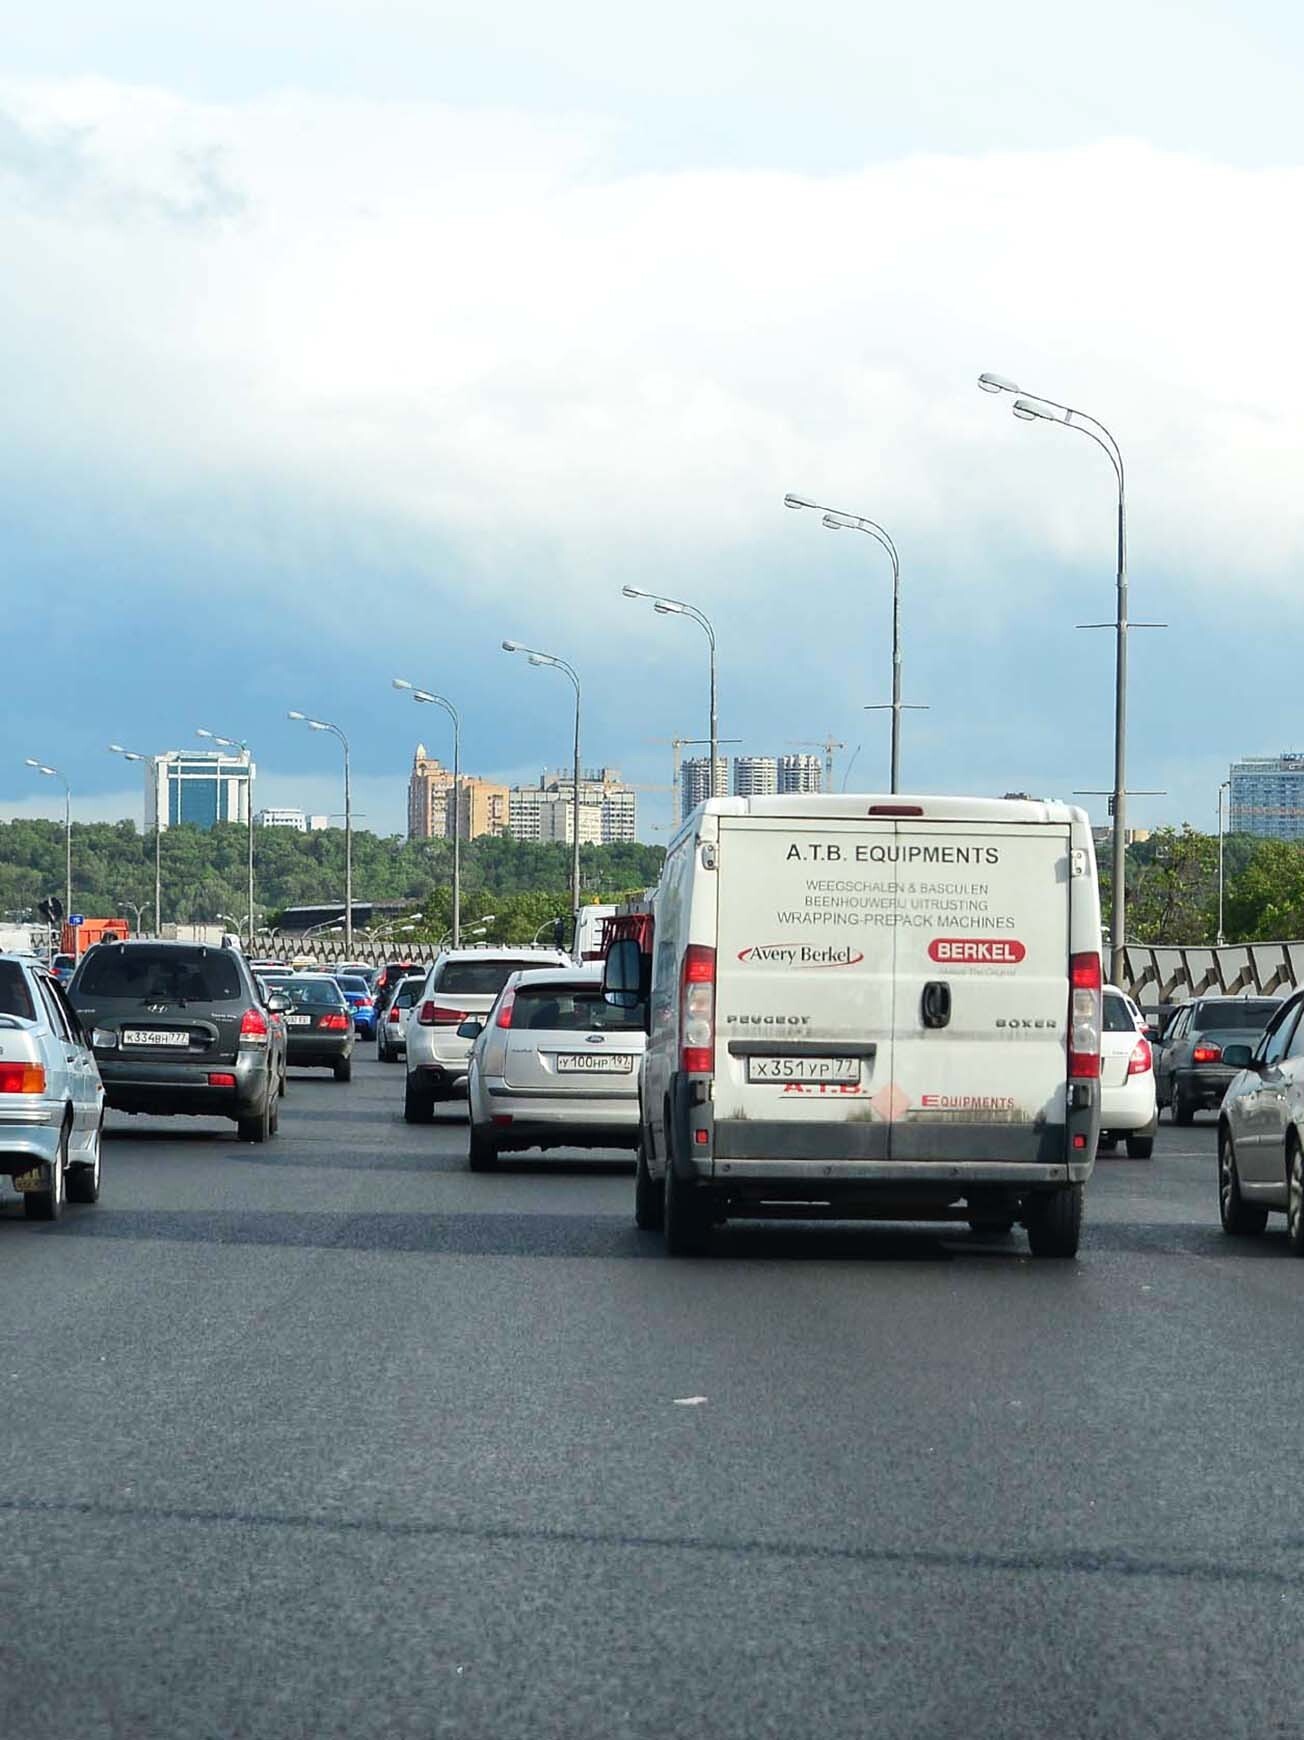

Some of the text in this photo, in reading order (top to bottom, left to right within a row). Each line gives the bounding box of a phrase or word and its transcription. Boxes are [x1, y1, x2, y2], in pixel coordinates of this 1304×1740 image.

[786, 844, 1000, 864] A.T.B. EQUIPMENTS
[806, 880, 905, 894] WEEGSCHALEN
[920, 882, 989, 896] BASCULEN
[911, 899, 989, 912] UITRUSTING
[777, 911, 1015, 929] WRAPPING-PREPACK MACHINES
[750, 946, 852, 965] Avery Berkel
[937, 942, 1016, 960] BERKEL
[727, 1015, 811, 1025] PEUGEOT
[995, 1019, 1057, 1029] BOXER
[921, 1094, 1015, 1109] EQUIPMENTS
